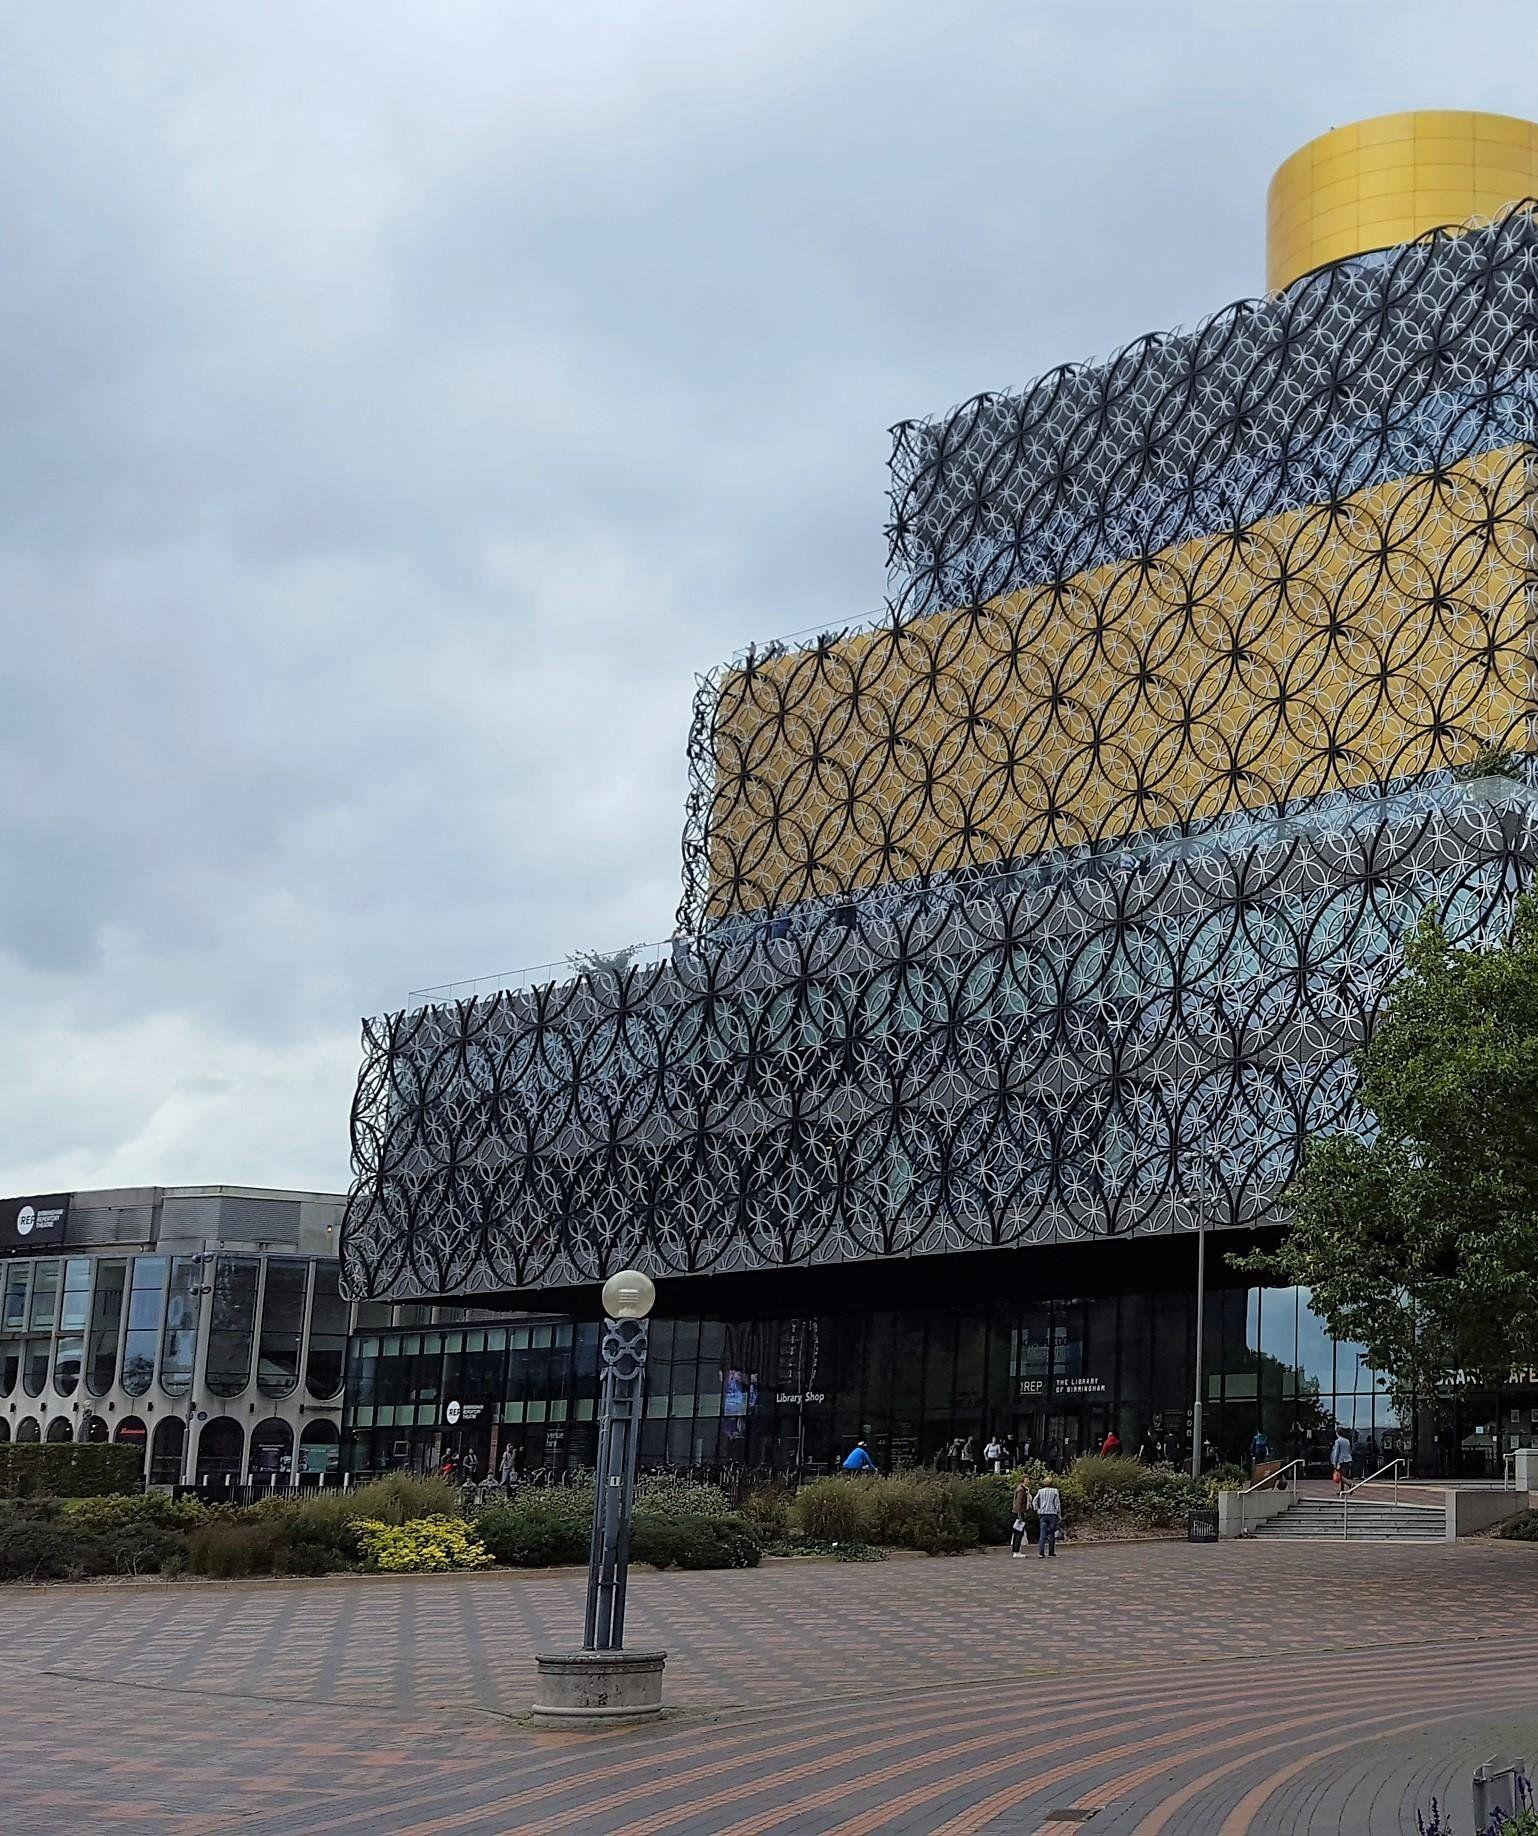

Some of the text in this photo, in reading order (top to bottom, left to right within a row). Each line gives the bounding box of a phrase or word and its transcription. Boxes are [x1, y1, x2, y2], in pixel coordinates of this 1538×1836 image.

[1071, 1378, 1099, 1386] LIBRARY
[1066, 1385, 1106, 1393] BIRMINGHAM
[776, 1392, 825, 1405] Library Shop
